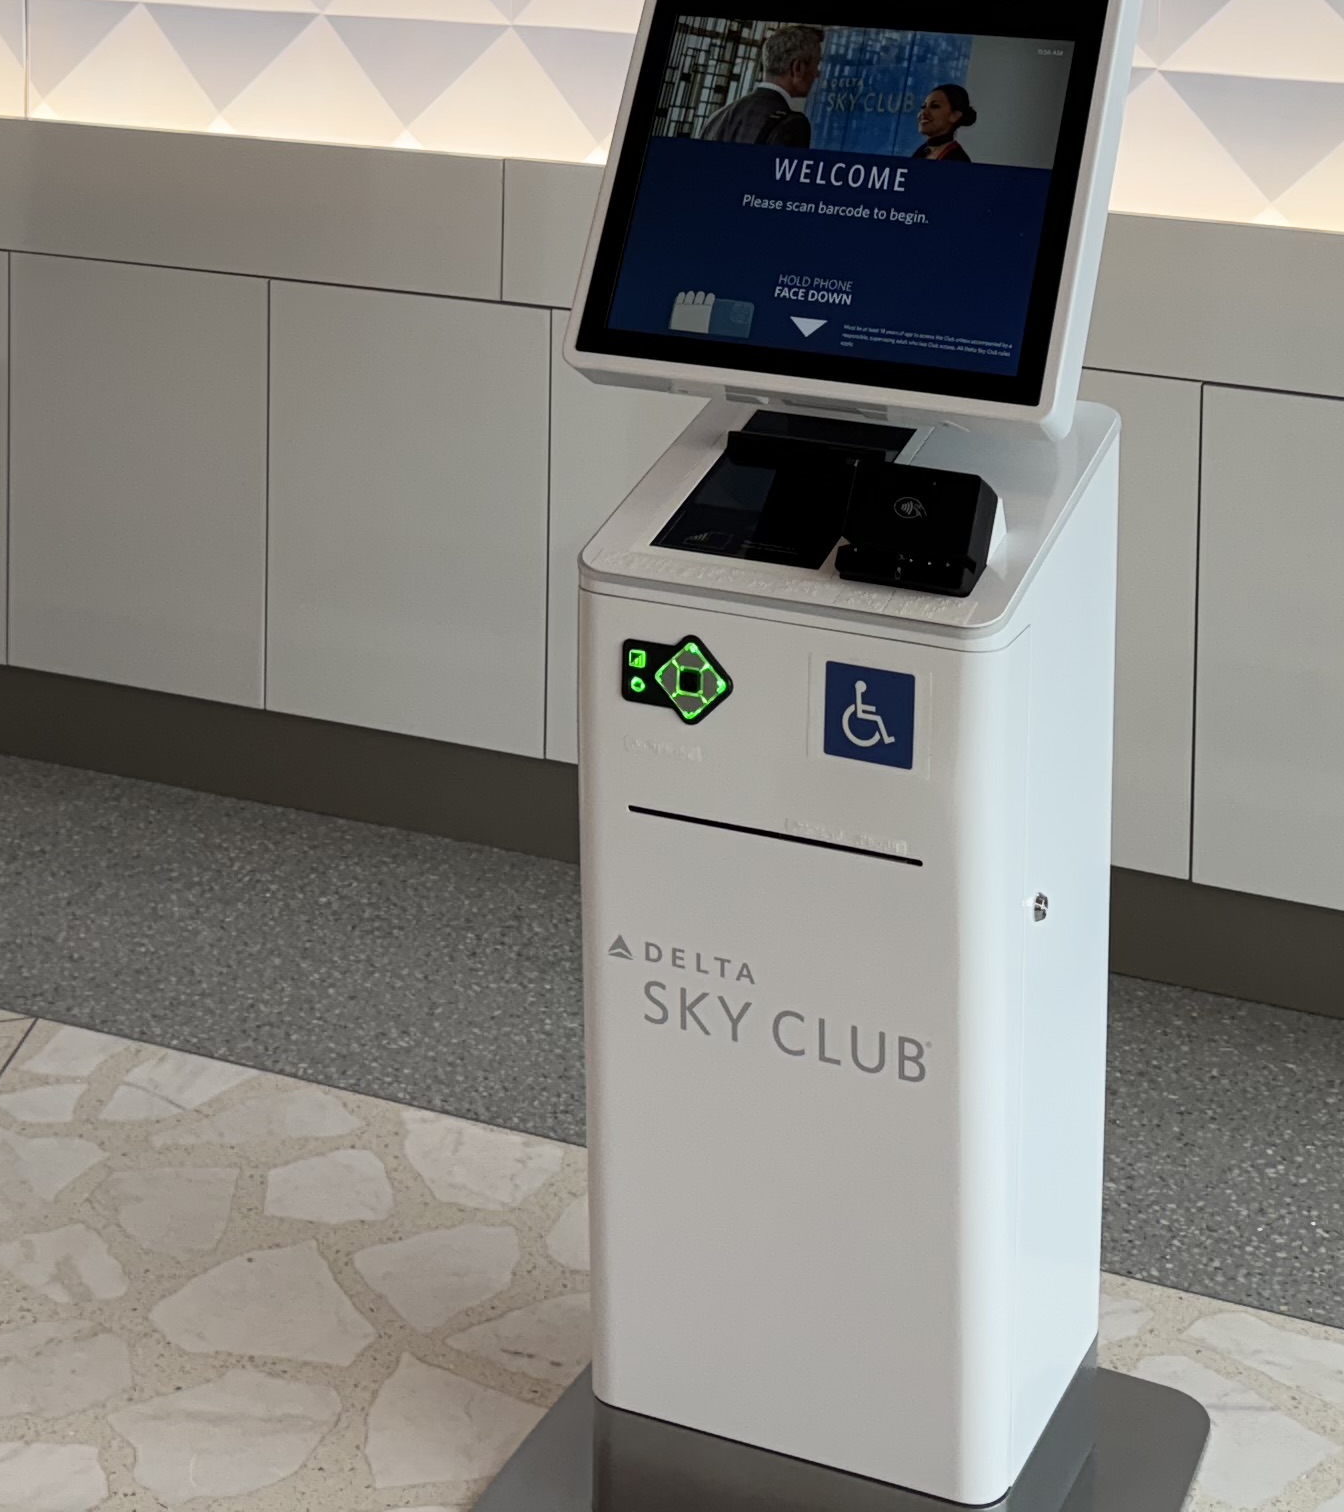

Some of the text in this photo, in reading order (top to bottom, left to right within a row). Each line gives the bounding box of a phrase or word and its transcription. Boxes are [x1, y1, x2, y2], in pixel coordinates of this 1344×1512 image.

[826, 91, 915, 113] SKY CLUB
[774, 157, 909, 192] WELCOME
[742, 194, 929, 225] Please scan barcode to begin.
[774, 287, 852, 306] FACE DOWN
[778, 274, 853, 292] HOLD PHONE
[644, 941, 755, 985] DELTA
[643, 980, 927, 1083] SKY CLUB
